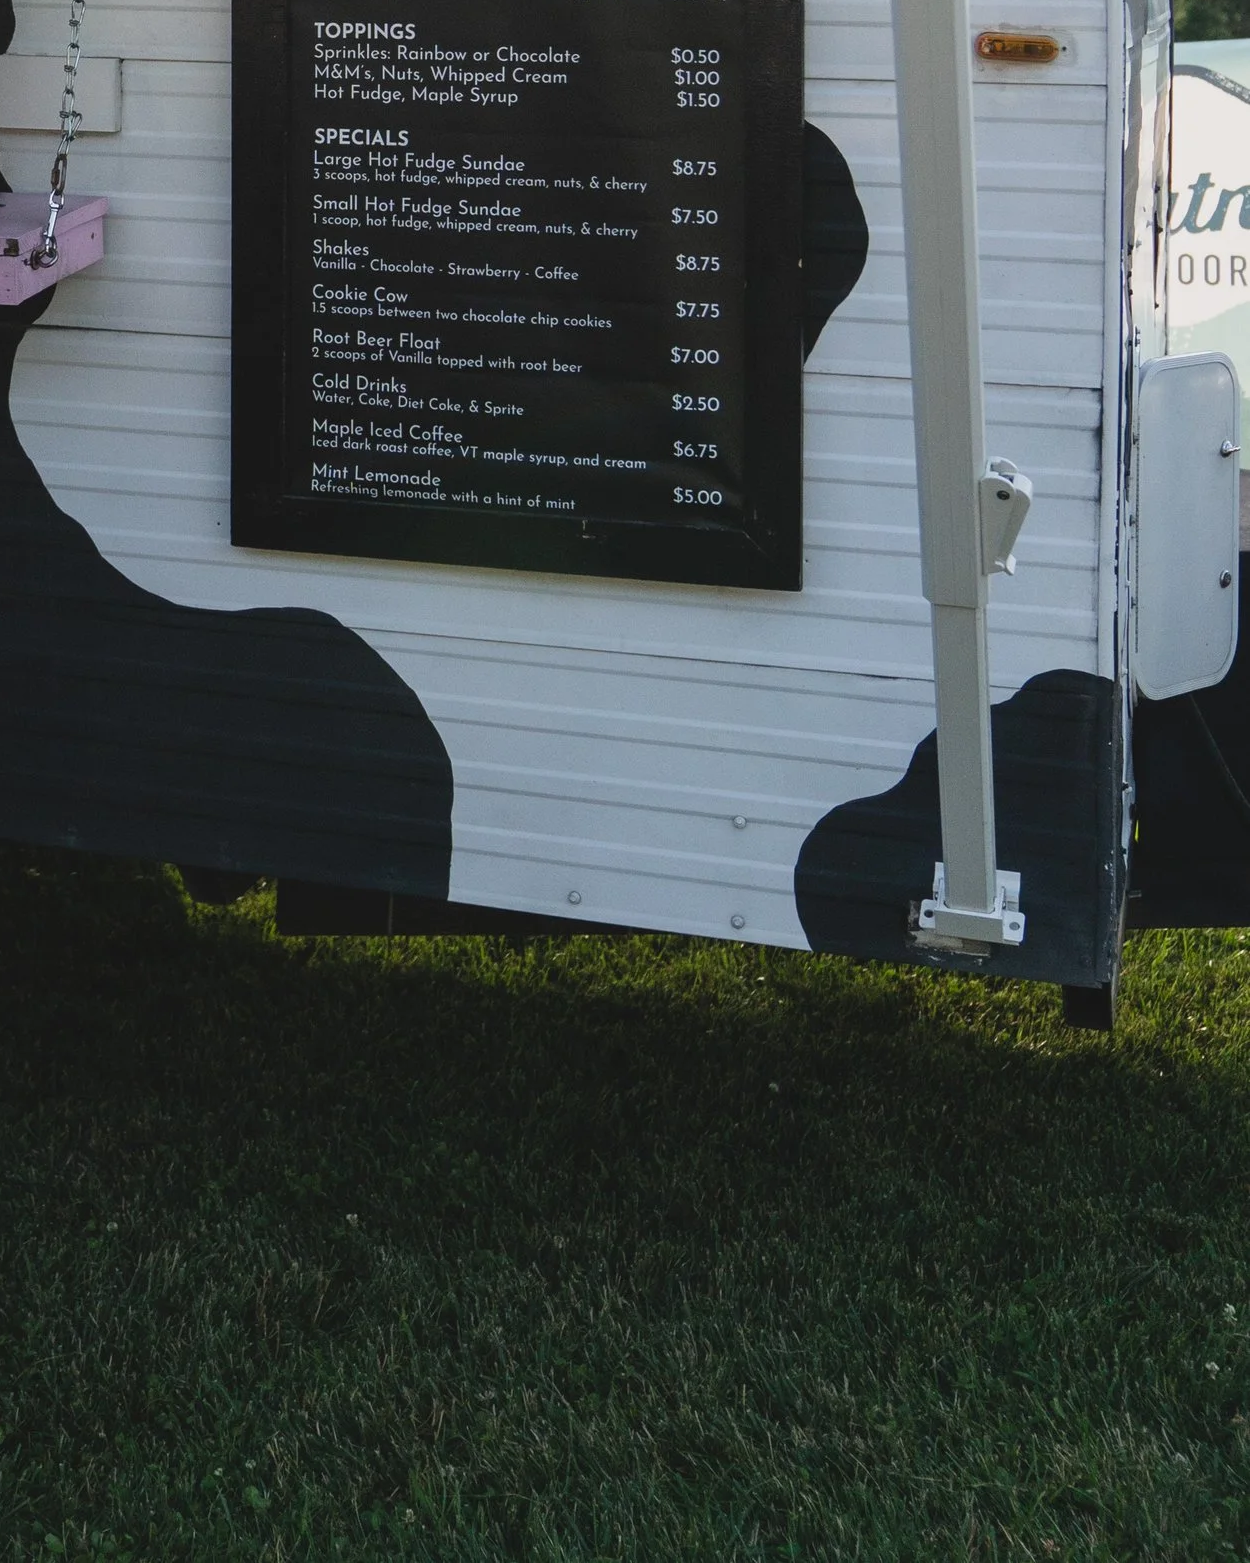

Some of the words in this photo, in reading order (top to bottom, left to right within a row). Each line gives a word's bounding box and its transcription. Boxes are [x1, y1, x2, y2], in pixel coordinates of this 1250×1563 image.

[313, 21, 416, 40] TOPPINGS
[313, 42, 391, 63] Sprinkles:
[397, 43, 467, 61] Rainbow
[472, 51, 491, 62] or
[496, 45, 581, 64] Chocolate
[670, 46, 721, 65] $0.50
[314, 62, 376, 83] M&M's,
[381, 64, 424, 83] Nuts,
[429, 64, 506, 86] Whipped
[512, 66, 568, 84] Cream
[674, 67, 721, 87] $1.00
[314, 83, 345, 100] Hot
[350, 83, 406, 105] Fudge,
[412, 85, 464, 106] Maple
[469, 86, 519, 107] Syrup
[676, 90, 721, 109] $1.50
[314, 127, 409, 147] SPECIALS
[313, 149, 362, 170] Large
[368, 151, 399, 168] Hot
[405, 151, 456, 173] Fudge
[461, 154, 526, 172] Sundae
[672, 158, 718, 177] $8.75
[313, 167, 321, 180] 3
[324, 171, 371, 184] scoops,
[374, 168, 397, 182] hot
[400, 168, 441, 187] fudge,
[444, 170, 501, 188] whipped
[504, 177, 549, 189] cream,
[554, 177, 585, 190] nuts,
[589, 175, 600, 189] &
[604, 176, 648, 194] cherry
[312, 193, 358, 211] Small
[365, 195, 396, 213] Hot
[401, 196, 453, 218] Fudge
[458, 199, 522, 217] Sundae
[671, 206, 719, 225] $7.50
[312, 238, 370, 257] Shakes
[675, 253, 721, 272] $8.75
[1177, 253, 1248, 287] OOR
[311, 301, 327, 314] 1.5
[330, 305, 374, 318] scoops
[377, 302, 431, 319] between
[435, 308, 458, 321] two
[462, 307, 527, 324] chocolate
[530, 311, 559, 328] chip
[563, 313, 613, 329] cookies
[312, 283, 368, 302] Cookie
[373, 286, 409, 303] Cow
[675, 299, 720, 319] $7.75
[313, 327, 351, 345] Root
[356, 329, 393, 348] Beer
[399, 331, 441, 351] Float
[670, 345, 720, 365] $7.00
[312, 372, 350, 390] Cold
[356, 374, 407, 394] Drinks
[671, 392, 721, 412] $2.50
[312, 417, 364, 438] Maple
[370, 421, 403, 439] Iced
[409, 424, 463, 444] Coffee
[673, 439, 718, 459] $6.75
[312, 461, 349, 480] Mint
[354, 464, 441, 487] Lemonade
[673, 486, 723, 506] $5.00
